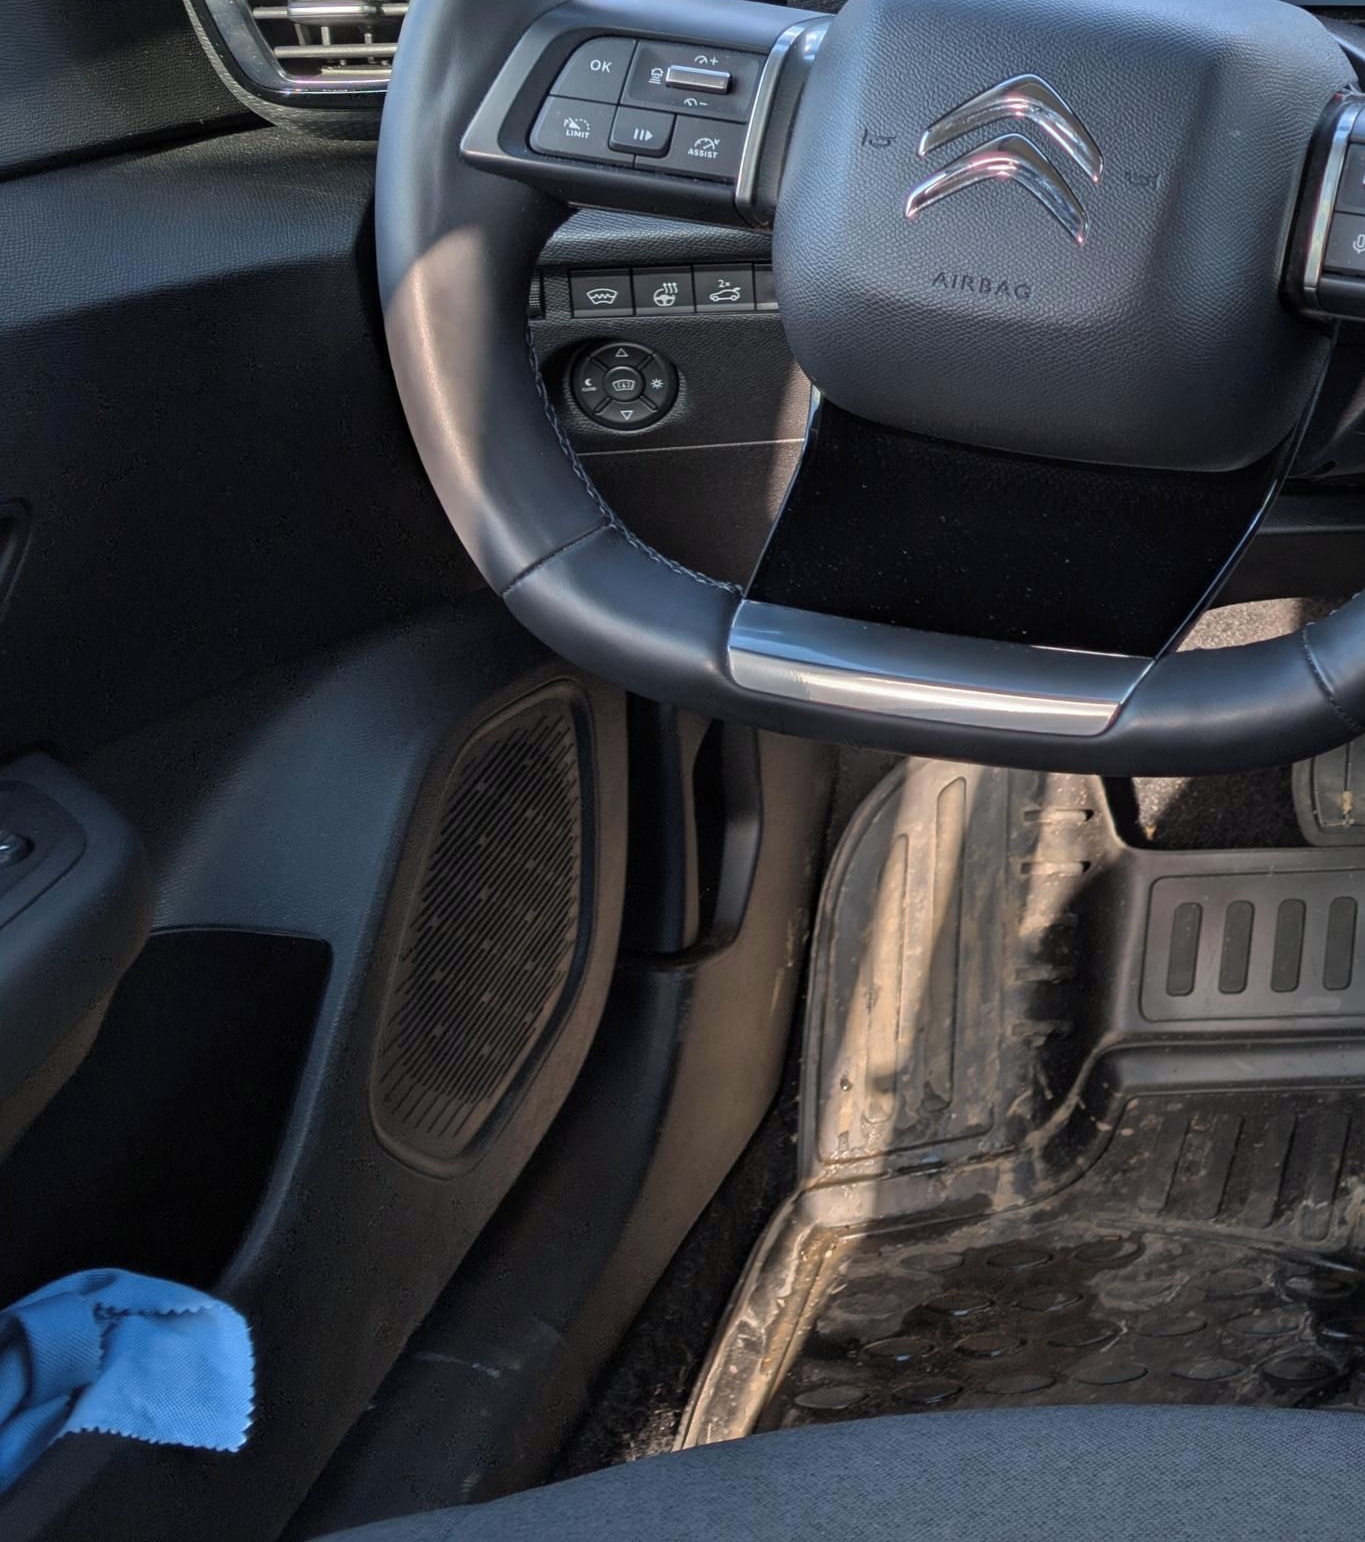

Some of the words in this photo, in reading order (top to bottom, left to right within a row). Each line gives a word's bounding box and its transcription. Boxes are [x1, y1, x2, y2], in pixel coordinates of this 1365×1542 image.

[590, 59, 612, 74] OK
[565, 128, 591, 139] LIMIT
[687, 147, 719, 159] ASSIST
[931, 271, 1032, 299] AIRBAG
